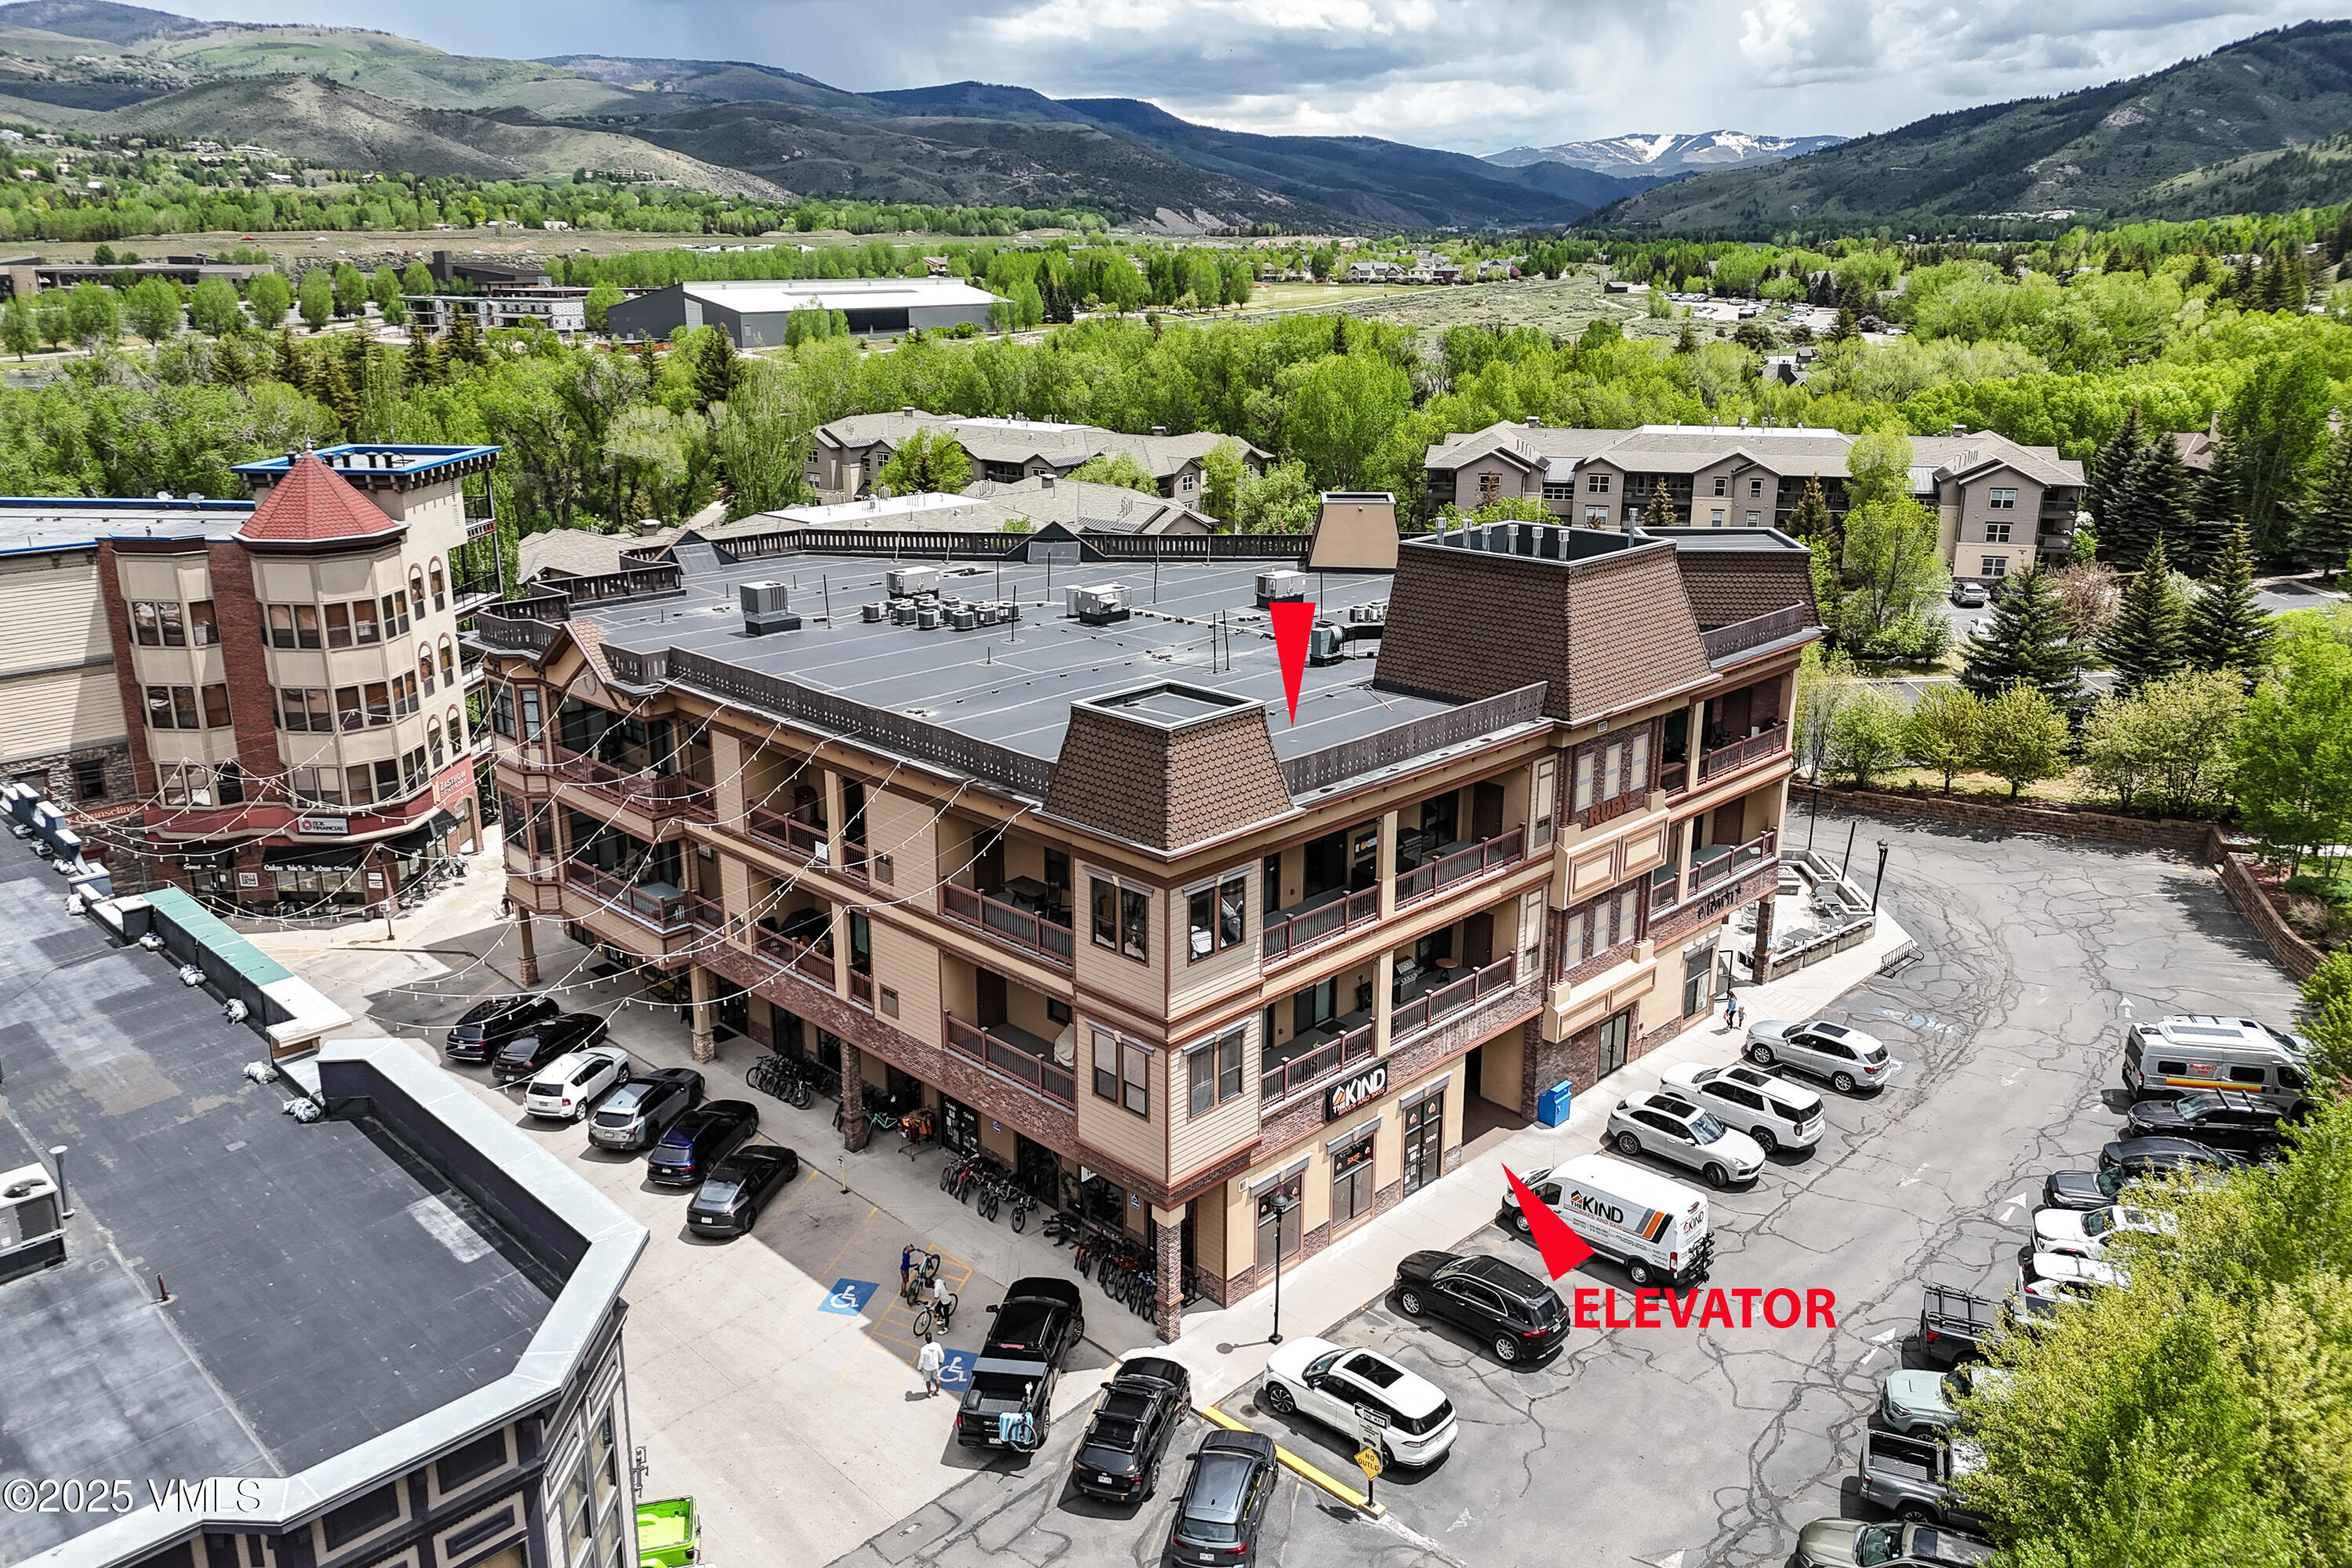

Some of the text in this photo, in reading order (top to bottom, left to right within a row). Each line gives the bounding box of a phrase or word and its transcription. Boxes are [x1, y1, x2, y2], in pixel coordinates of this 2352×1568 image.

[440, 769, 466, 791] ZASTROW
[1588, 793, 1634, 827] RUBY
[1333, 1068, 1386, 1114] THE KIND
[1338, 1087, 1385, 1116] BIKES AND SKIS
[1570, 1196, 1624, 1223] THE KIND
[1579, 1210, 1595, 1220] BIKES
[1596, 1217, 1608, 1225] AND
[1689, 1210, 1704, 1232] KIND
[1365, 1453, 1375, 1461] NO
